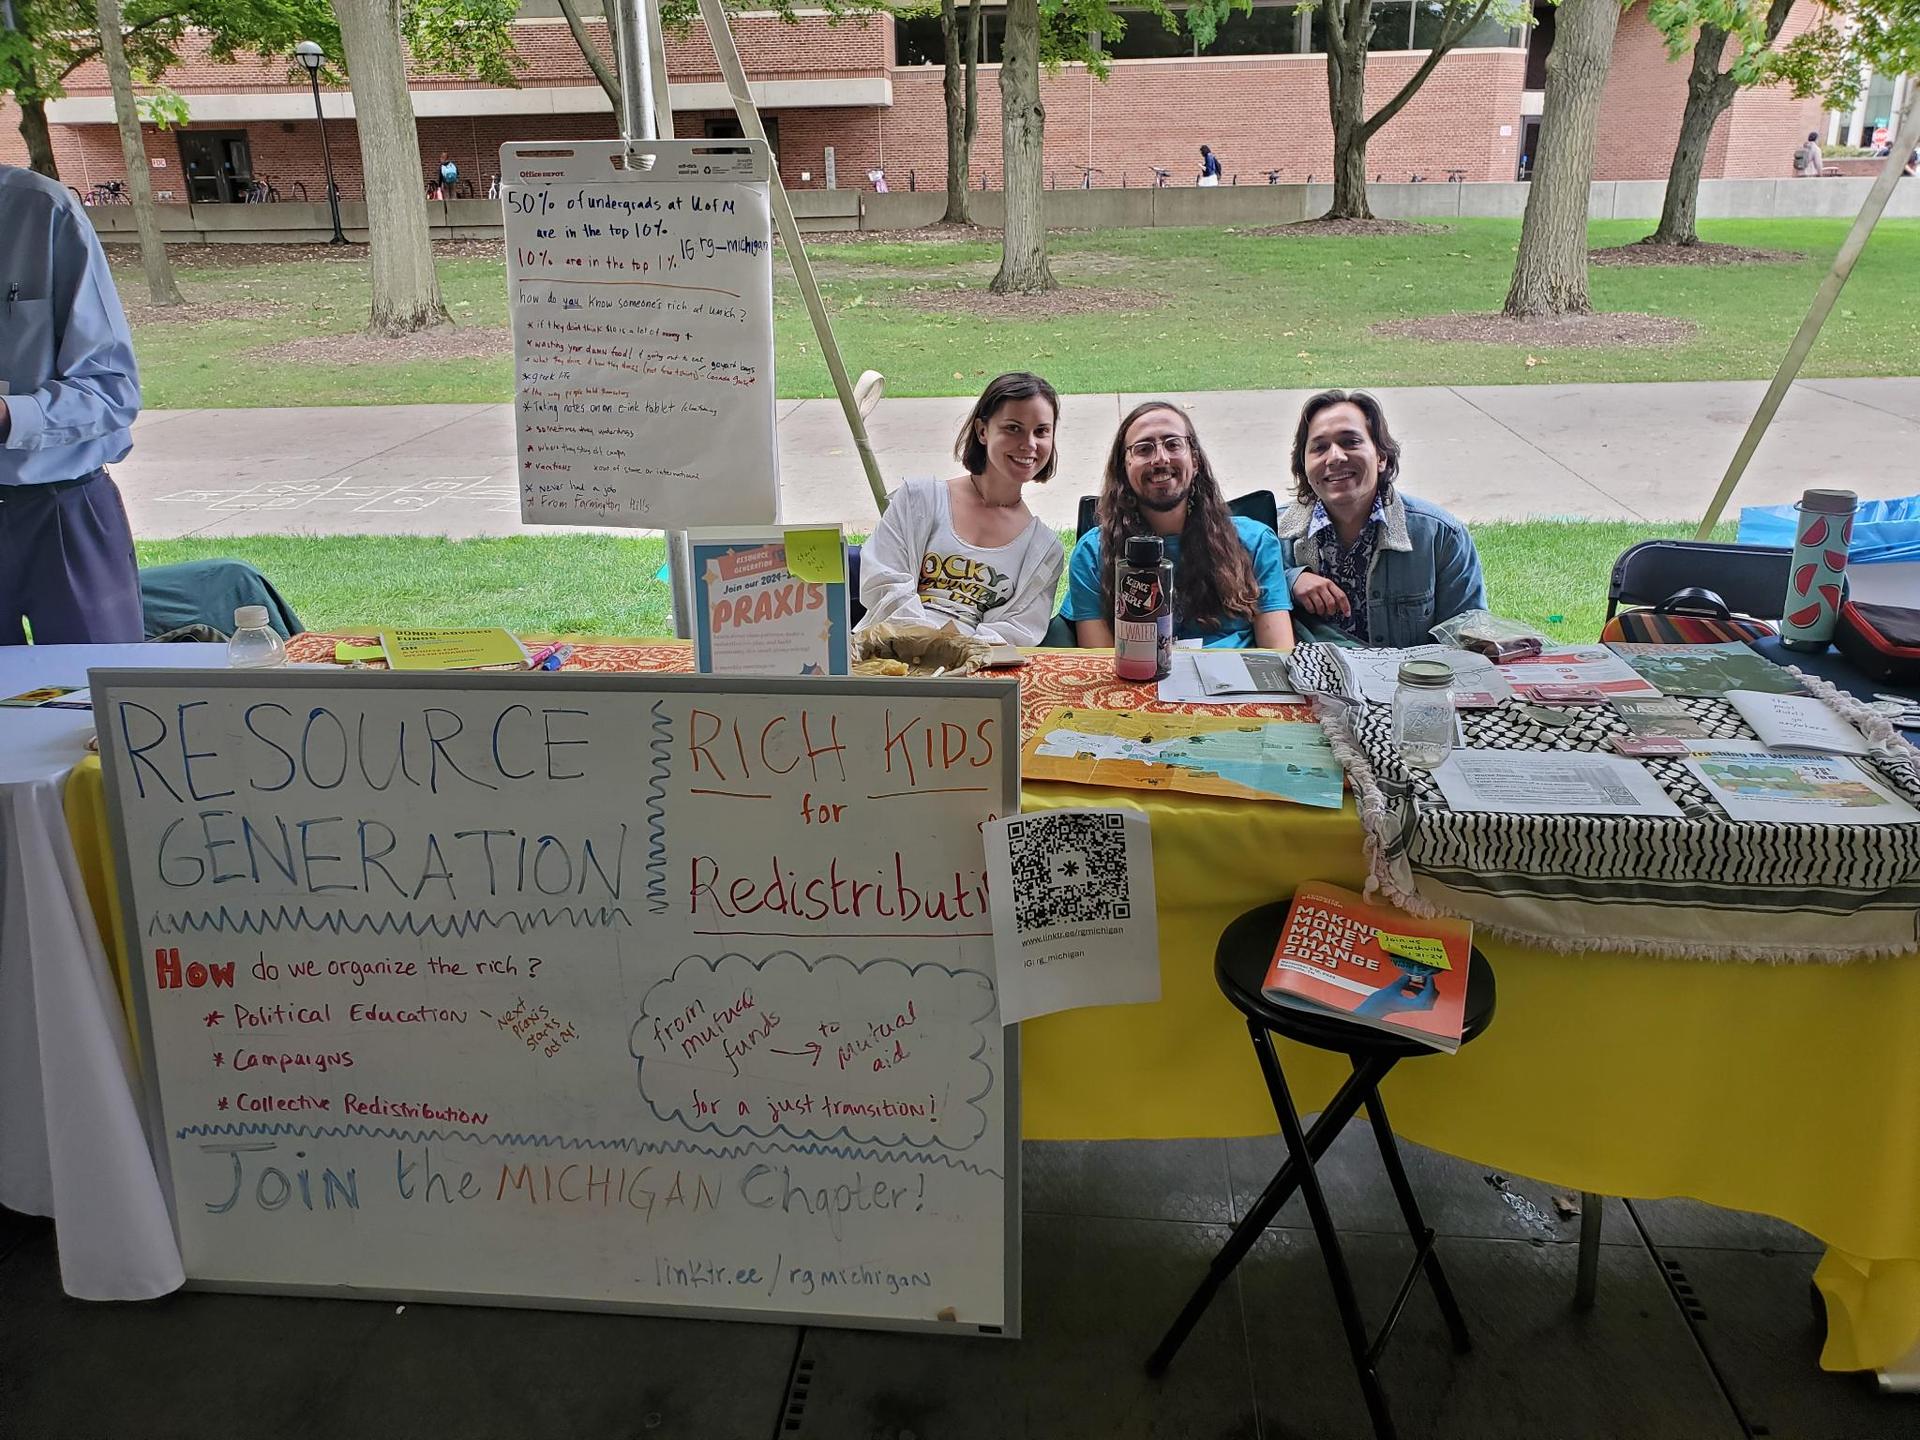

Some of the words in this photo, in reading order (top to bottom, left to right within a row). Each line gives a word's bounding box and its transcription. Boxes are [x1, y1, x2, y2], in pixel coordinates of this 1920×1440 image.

[508, 191, 555, 215] 50%
[567, 192, 583, 210] of
[588, 195, 661, 216] undergrads
[668, 197, 682, 211] at
[536, 227, 555, 239] are
[566, 226, 576, 238] in
[583, 223, 600, 238] the
[609, 225, 629, 240] top
[635, 219, 668, 237] 10%
[518, 248, 553, 268] 10%
[566, 258, 582, 267] are
[589, 256, 599, 268] in
[606, 254, 625, 270] the
[632, 258, 649, 274] top
[519, 289, 539, 304] how
[548, 291, 557, 304] do
[563, 298, 582, 310] you
[619, 298, 661, 310] someone's
[667, 301, 687, 311] rich
[693, 304, 703, 314] at
[537, 320, 545, 329] if
[548, 320, 564, 333] they
[534, 339, 564, 352] wasting
[563, 399, 585, 414] notes
[645, 398, 676, 414] tablet
[569, 479, 585, 492] had
[601, 485, 617, 498] job
[541, 494, 567, 509] From
[574, 493, 620, 518] Farmington
[629, 496, 651, 514] Hills
[919, 552, 1010, 587] OCKY
[723, 583, 743, 596] Join
[744, 579, 758, 590] our
[1125, 575, 1150, 593] SCIENCE
[712, 583, 825, 634] PRAXIS
[120, 701, 590, 803] RESOURCE
[689, 709, 846, 783] RICH
[884, 708, 995, 786] KIDS
[800, 793, 848, 824] for
[158, 810, 628, 900] GENERATION
[1021, 926, 1125, 948] www.linktr.ee/rgmichigan
[1290, 924, 1355, 951] MAKE
[1293, 914, 1373, 946] MONEY
[1283, 944, 1339, 970] 2023
[1286, 935, 1382, 972] CHANGE
[252, 951, 279, 981] do
[289, 958, 322, 977] we
[328, 958, 418, 987] organize
[427, 956, 468, 976] the
[235, 1003, 330, 1029] Political
[653, 998, 706, 1052] from
[818, 1020, 841, 1038] to
[723, 1010, 782, 1078] funds
[872, 1041, 911, 1073] aid
[237, 1093, 331, 1115] Collective
[692, 1088, 721, 1119] for
[738, 1099, 751, 1115] a
[767, 1093, 815, 1124] just
[821, 1093, 938, 1123] transition!
[397, 1147, 481, 1203] the
[497, 1163, 723, 1223] MICHIGAN
[740, 1163, 926, 1242] Chapter!
